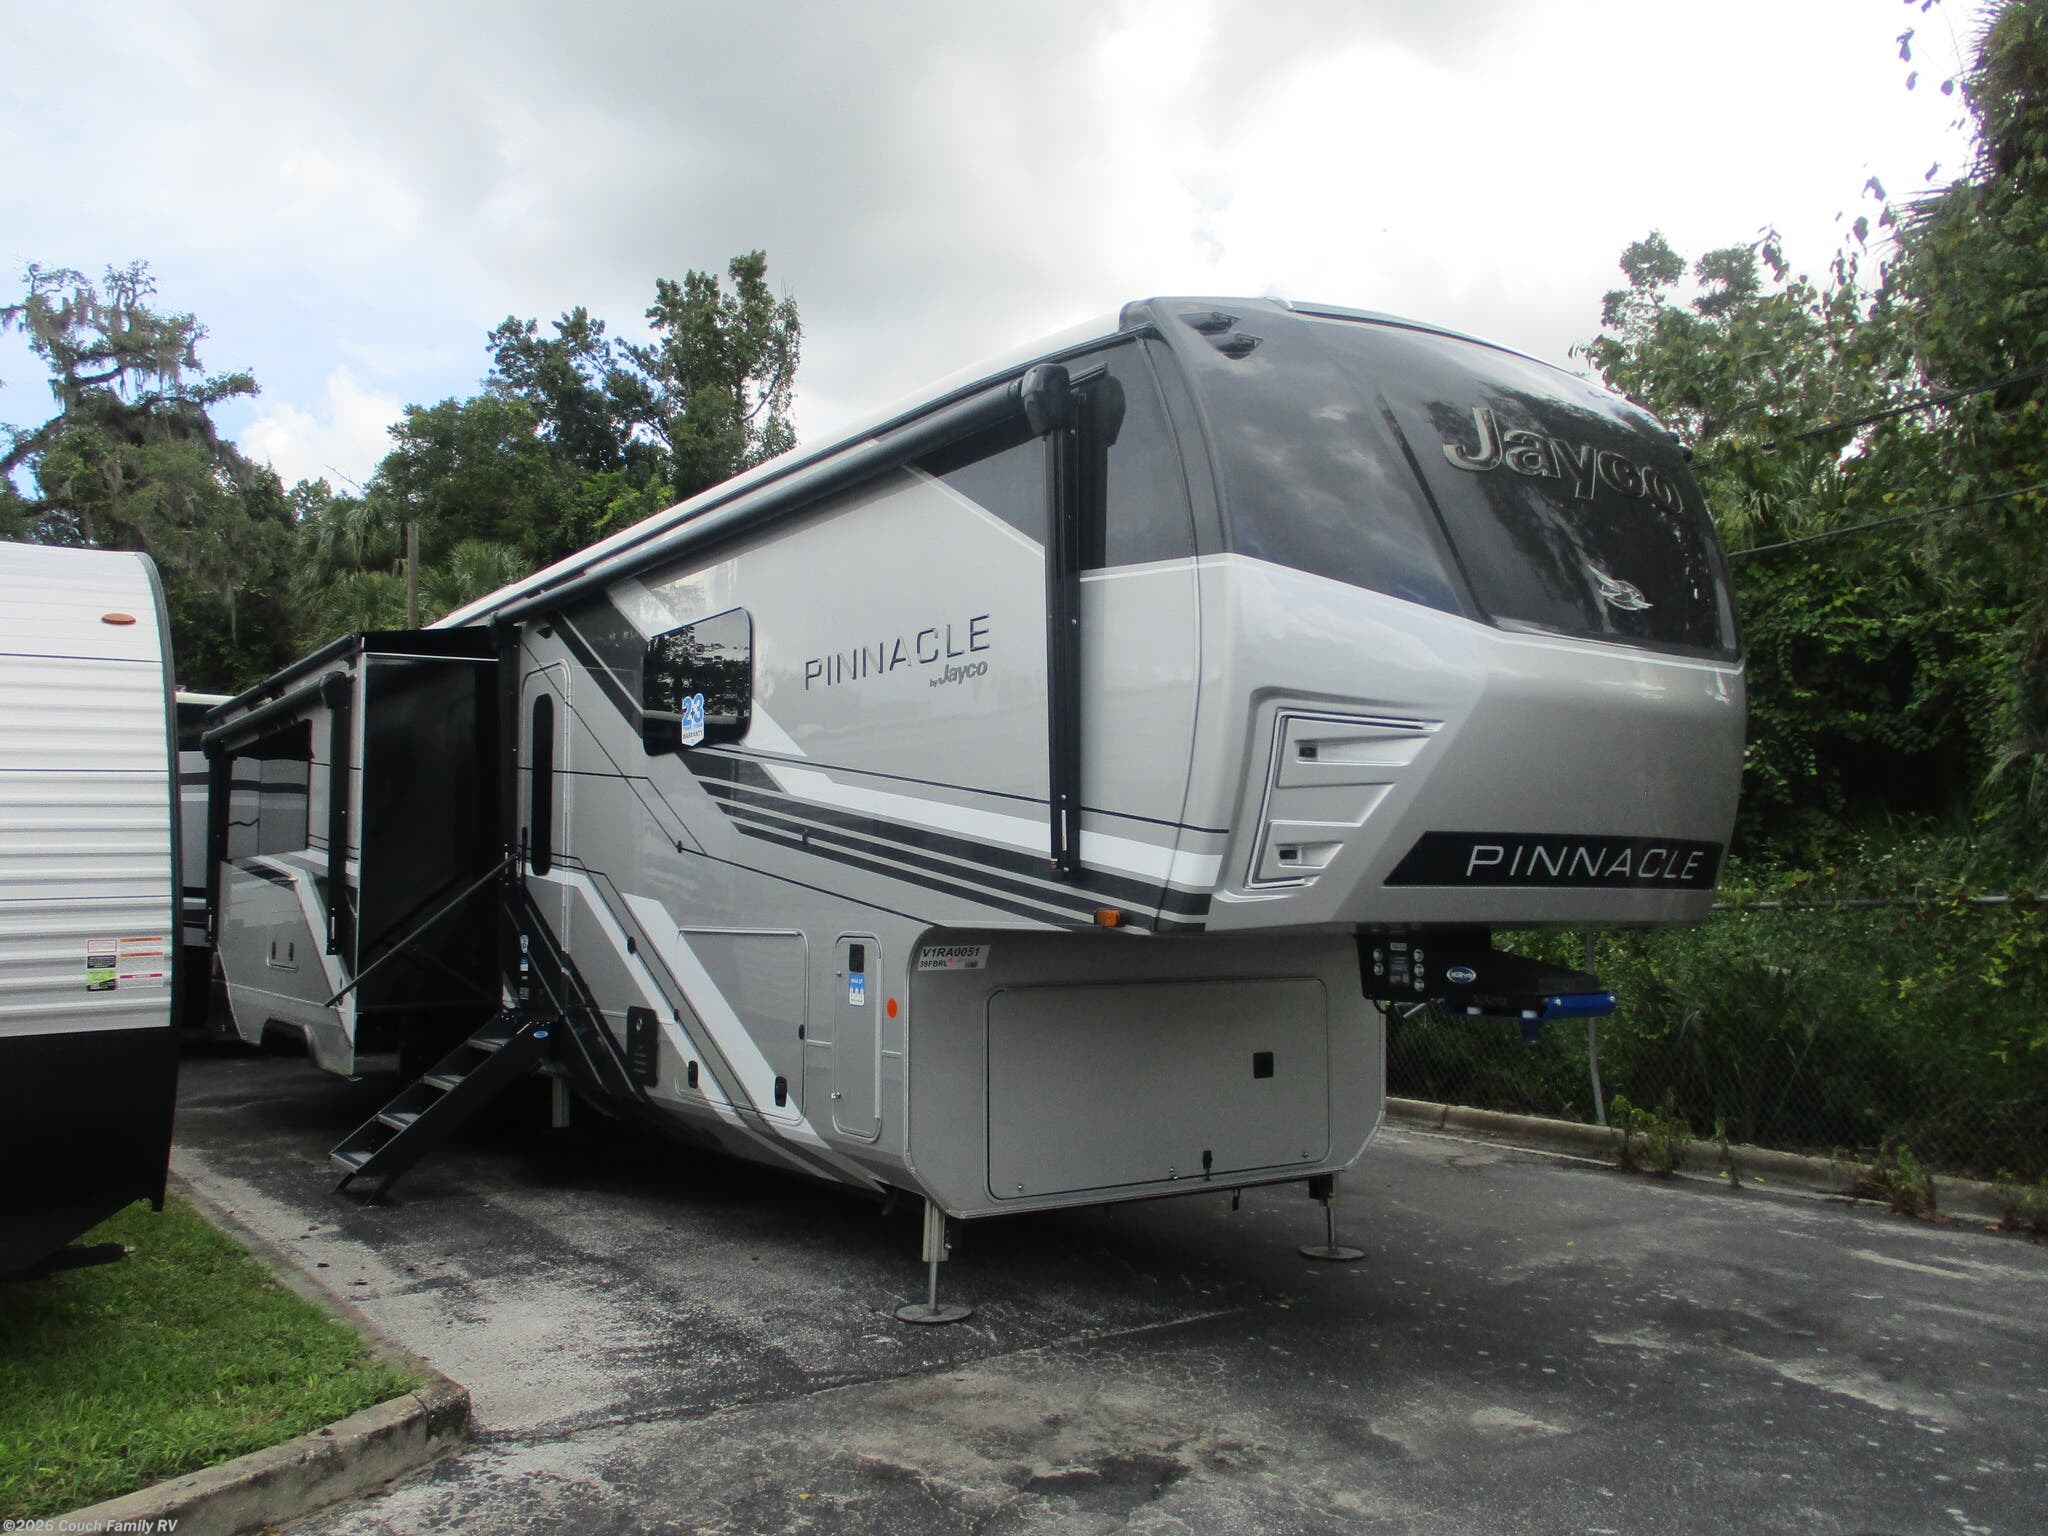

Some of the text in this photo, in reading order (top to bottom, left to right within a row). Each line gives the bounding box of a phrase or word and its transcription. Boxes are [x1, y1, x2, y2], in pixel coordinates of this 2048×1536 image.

[1442, 407, 1685, 514] Jayco
[804, 613, 990, 691] PINNACLE
[929, 661, 989, 688] by Jayco
[1465, 845, 1705, 880] PINNACLE
[922, 947, 981, 958] V1RA0051
